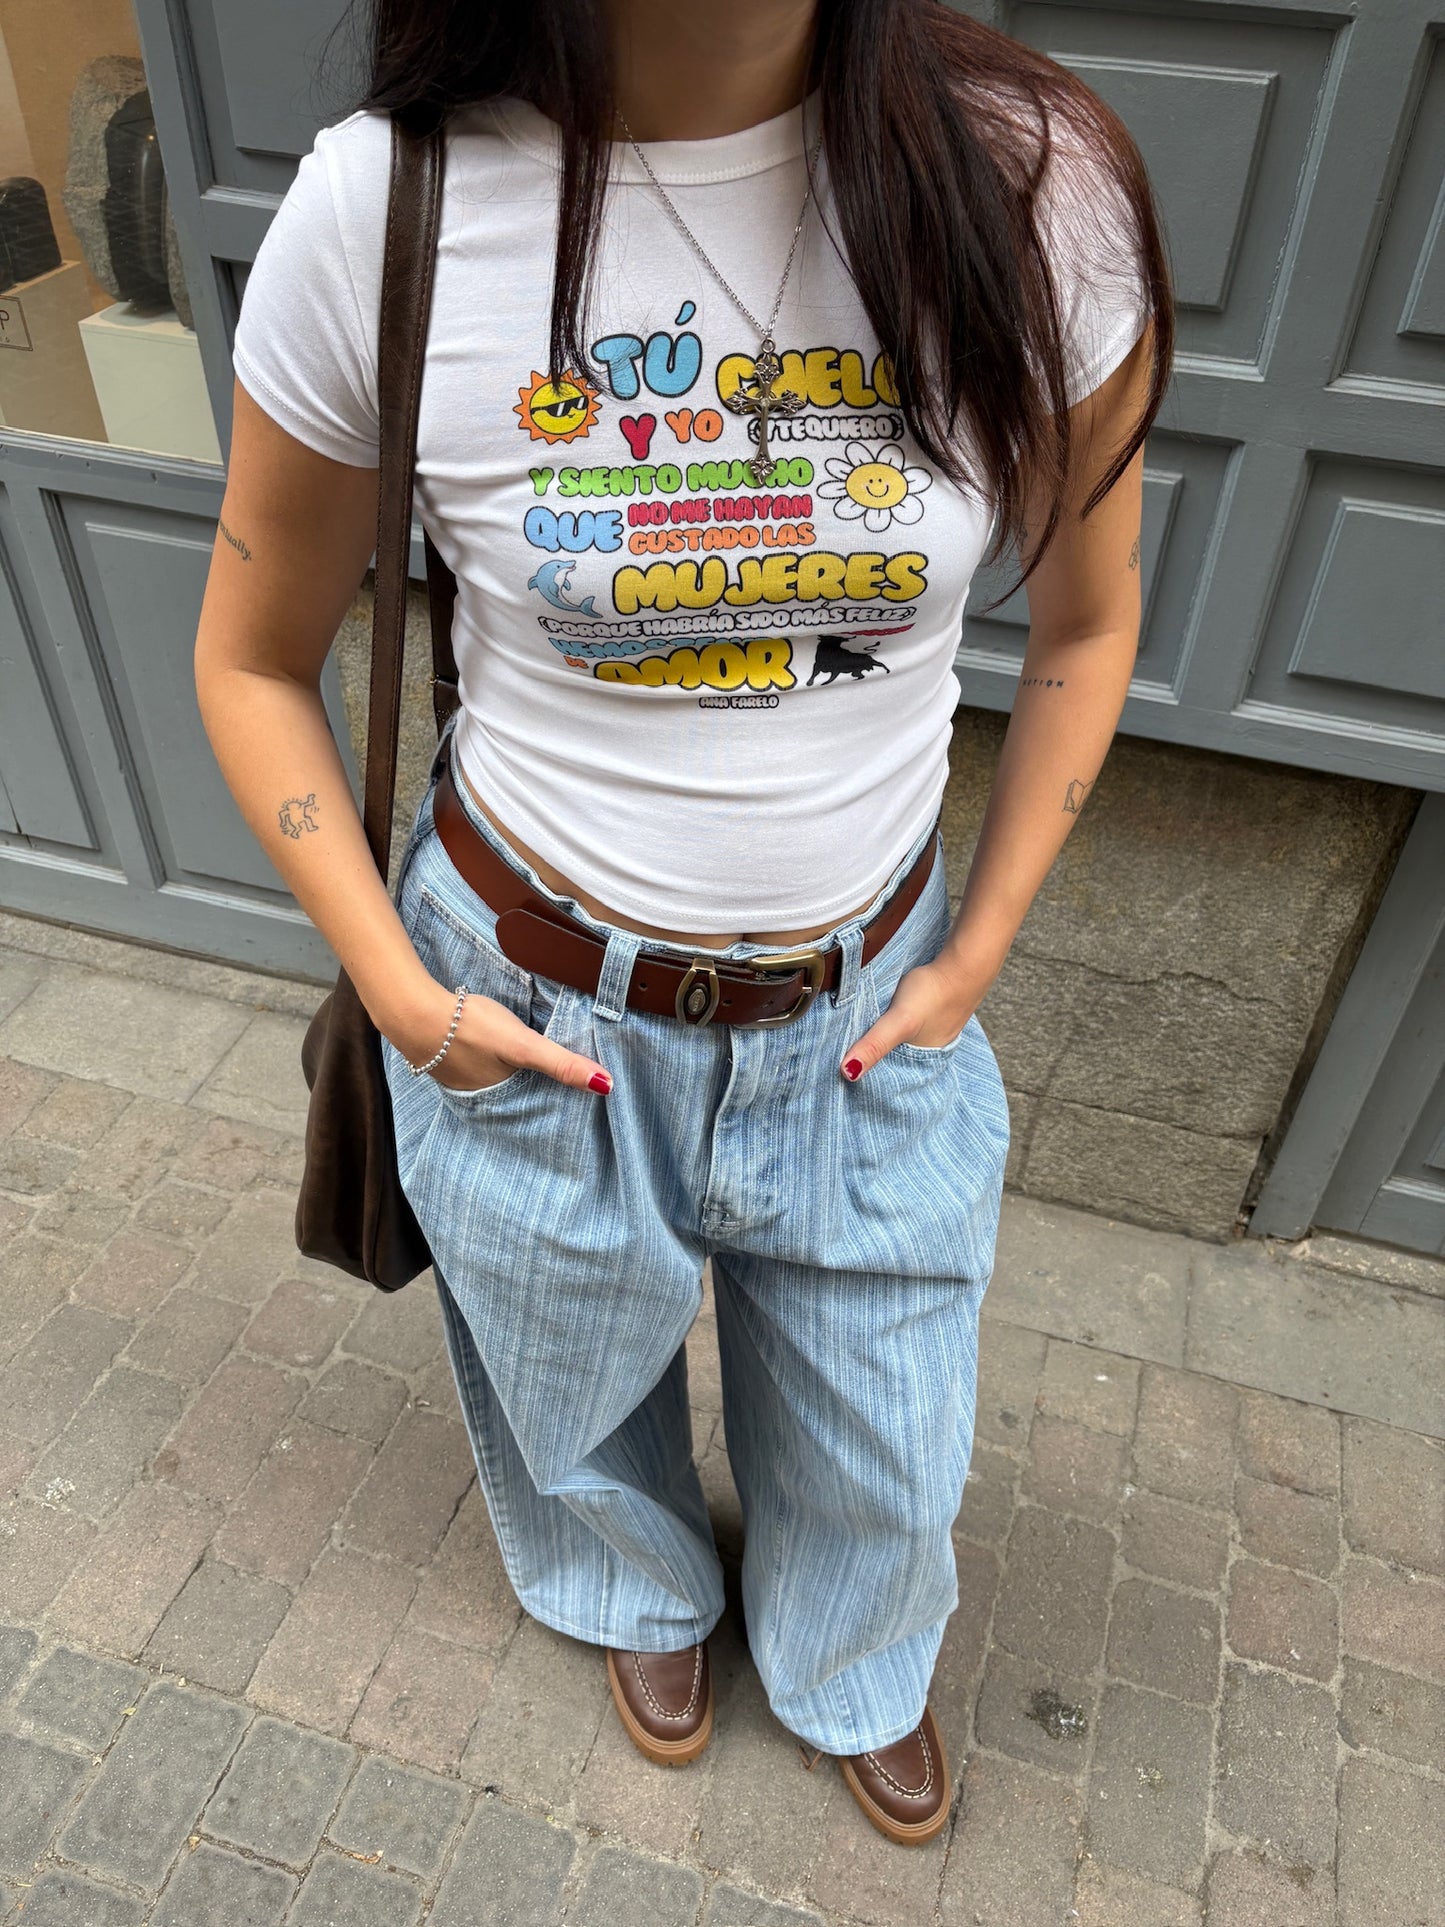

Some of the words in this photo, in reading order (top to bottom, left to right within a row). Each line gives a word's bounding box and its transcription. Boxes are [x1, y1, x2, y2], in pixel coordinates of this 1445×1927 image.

[591, 300, 702, 400] TÚ
[619, 413, 657, 460] Y
[664, 408, 724, 443] YO
[528, 467, 554, 496] Y
[558, 463, 682, 497] SIENTO
[523, 505, 624, 553] QUE
[627, 500, 669, 527] NO
[670, 498, 712, 525] ME
[713, 494, 814, 522] HAYAN
[628, 525, 760, 555] GUSTADO
[762, 522, 817, 547] LAS
[612, 552, 929, 615] MUJERES
[643, 609, 735, 636] HABRÍA
[734, 609, 791, 630] SIDO
[791, 602, 845, 626] MÁS
[845, 606, 917, 622] FELIZ)
[593, 638, 798, 693] AMOR
[699, 696, 729, 709] ANA
[730, 694, 779, 709] FARELO
